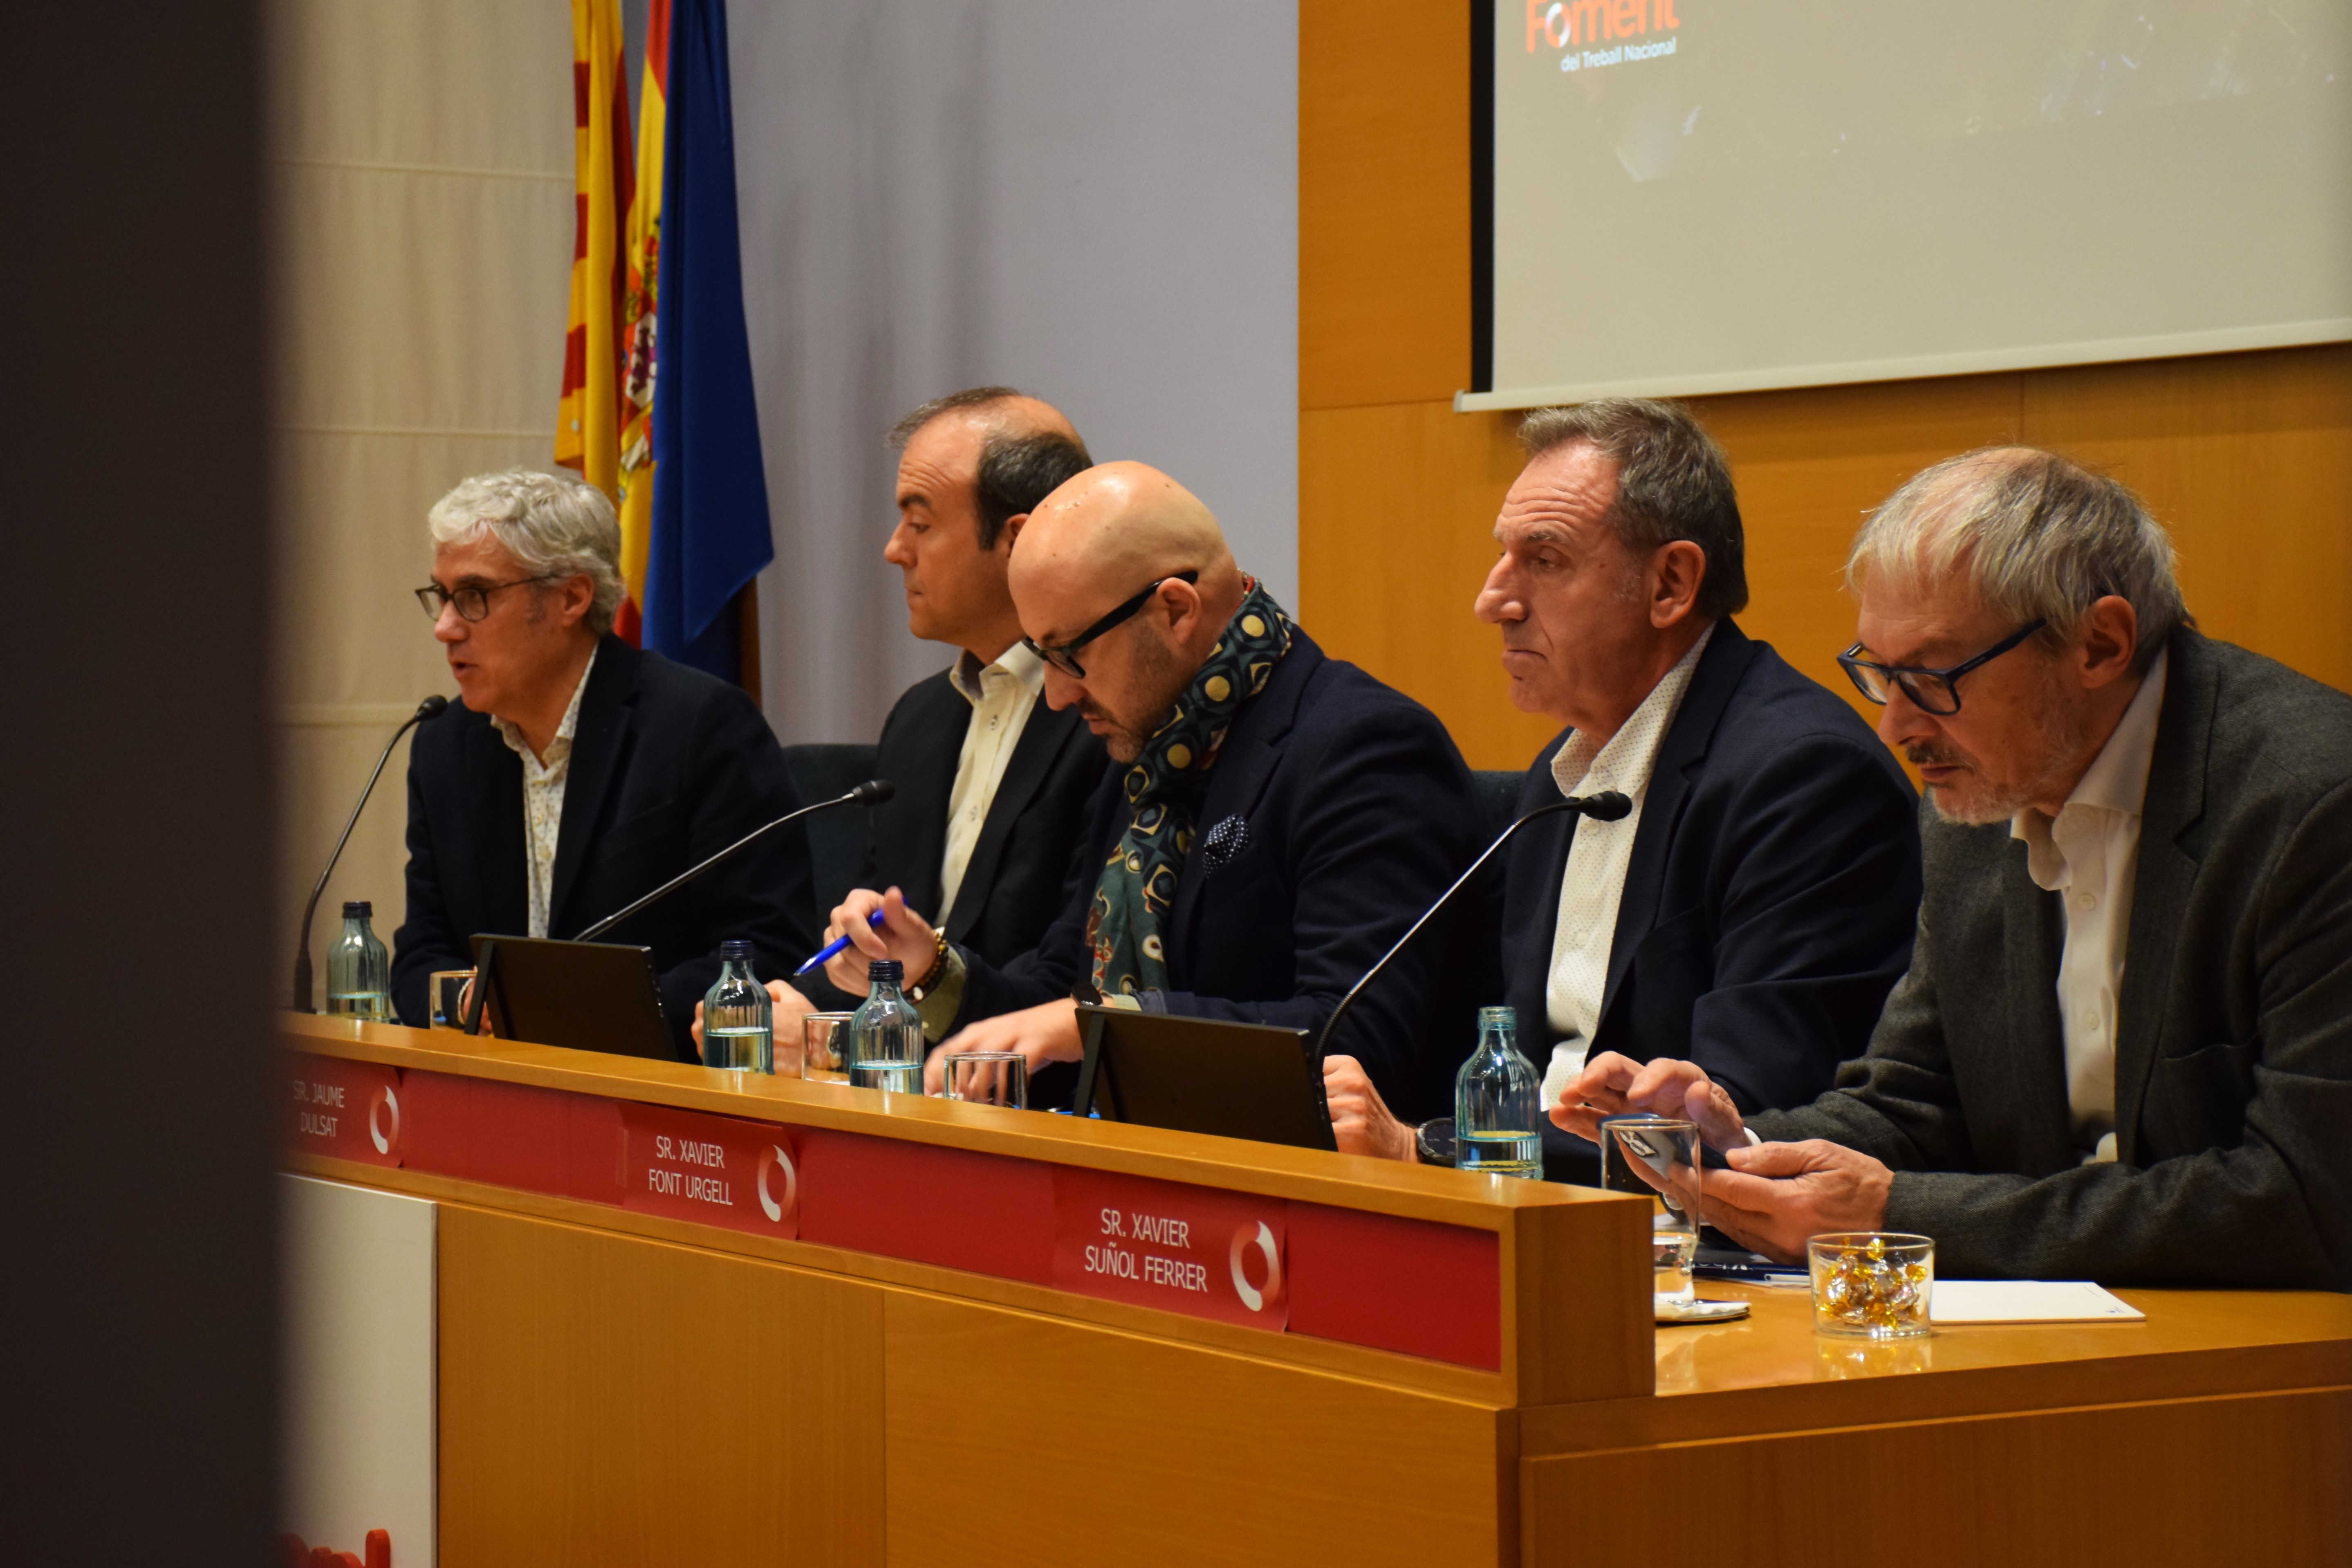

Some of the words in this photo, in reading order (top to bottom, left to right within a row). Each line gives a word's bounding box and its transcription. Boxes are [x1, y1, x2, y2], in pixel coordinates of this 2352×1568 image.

[1561, 52, 1579, 72] del
[1582, 46, 1622, 68] Treball
[1624, 36, 1676, 61] Nacional
[312, 1083, 344, 1108] JAUME
[301, 1112, 338, 1137] DULSAT
[656, 1135, 676, 1160] SR.
[679, 1139, 725, 1169] XAVIER
[648, 1169, 682, 1196] FONT
[685, 1175, 733, 1206] URGELL
[1101, 1208, 1126, 1237] SR.
[1132, 1213, 1190, 1249] XAVIER
[1085, 1241, 1139, 1280] SUÑOL
[1144, 1256, 1208, 1292] FERRER
